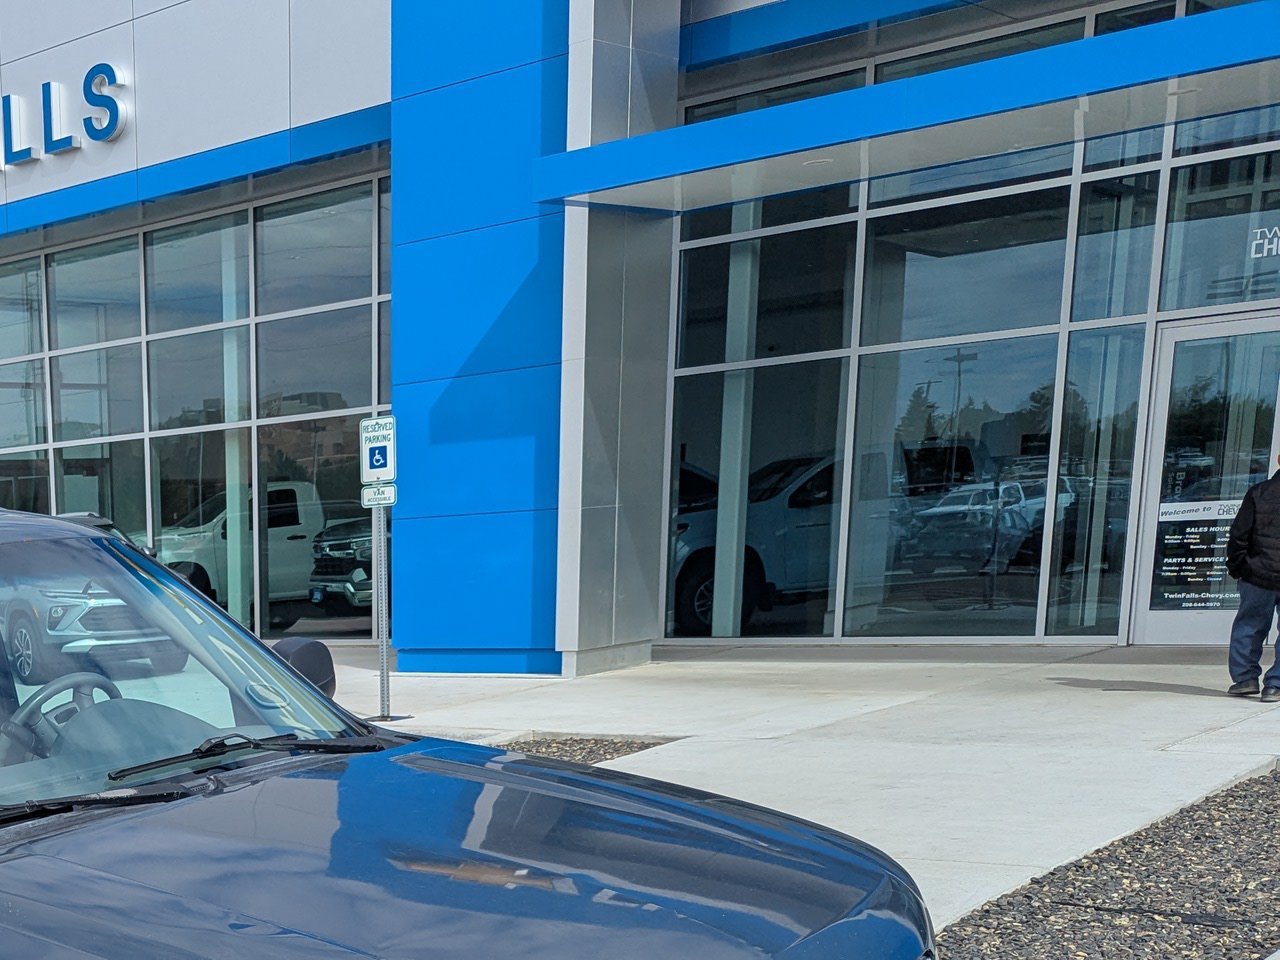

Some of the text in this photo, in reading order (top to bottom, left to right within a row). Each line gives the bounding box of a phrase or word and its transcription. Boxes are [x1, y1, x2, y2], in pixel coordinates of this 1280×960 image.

[362, 422, 393, 433] RESERVED
[365, 433, 391, 444] PARKING
[373, 489, 385, 497] VAN
[367, 495, 392, 503] ACCESSIBLE
[1160, 507, 1201, 517] Welcome
